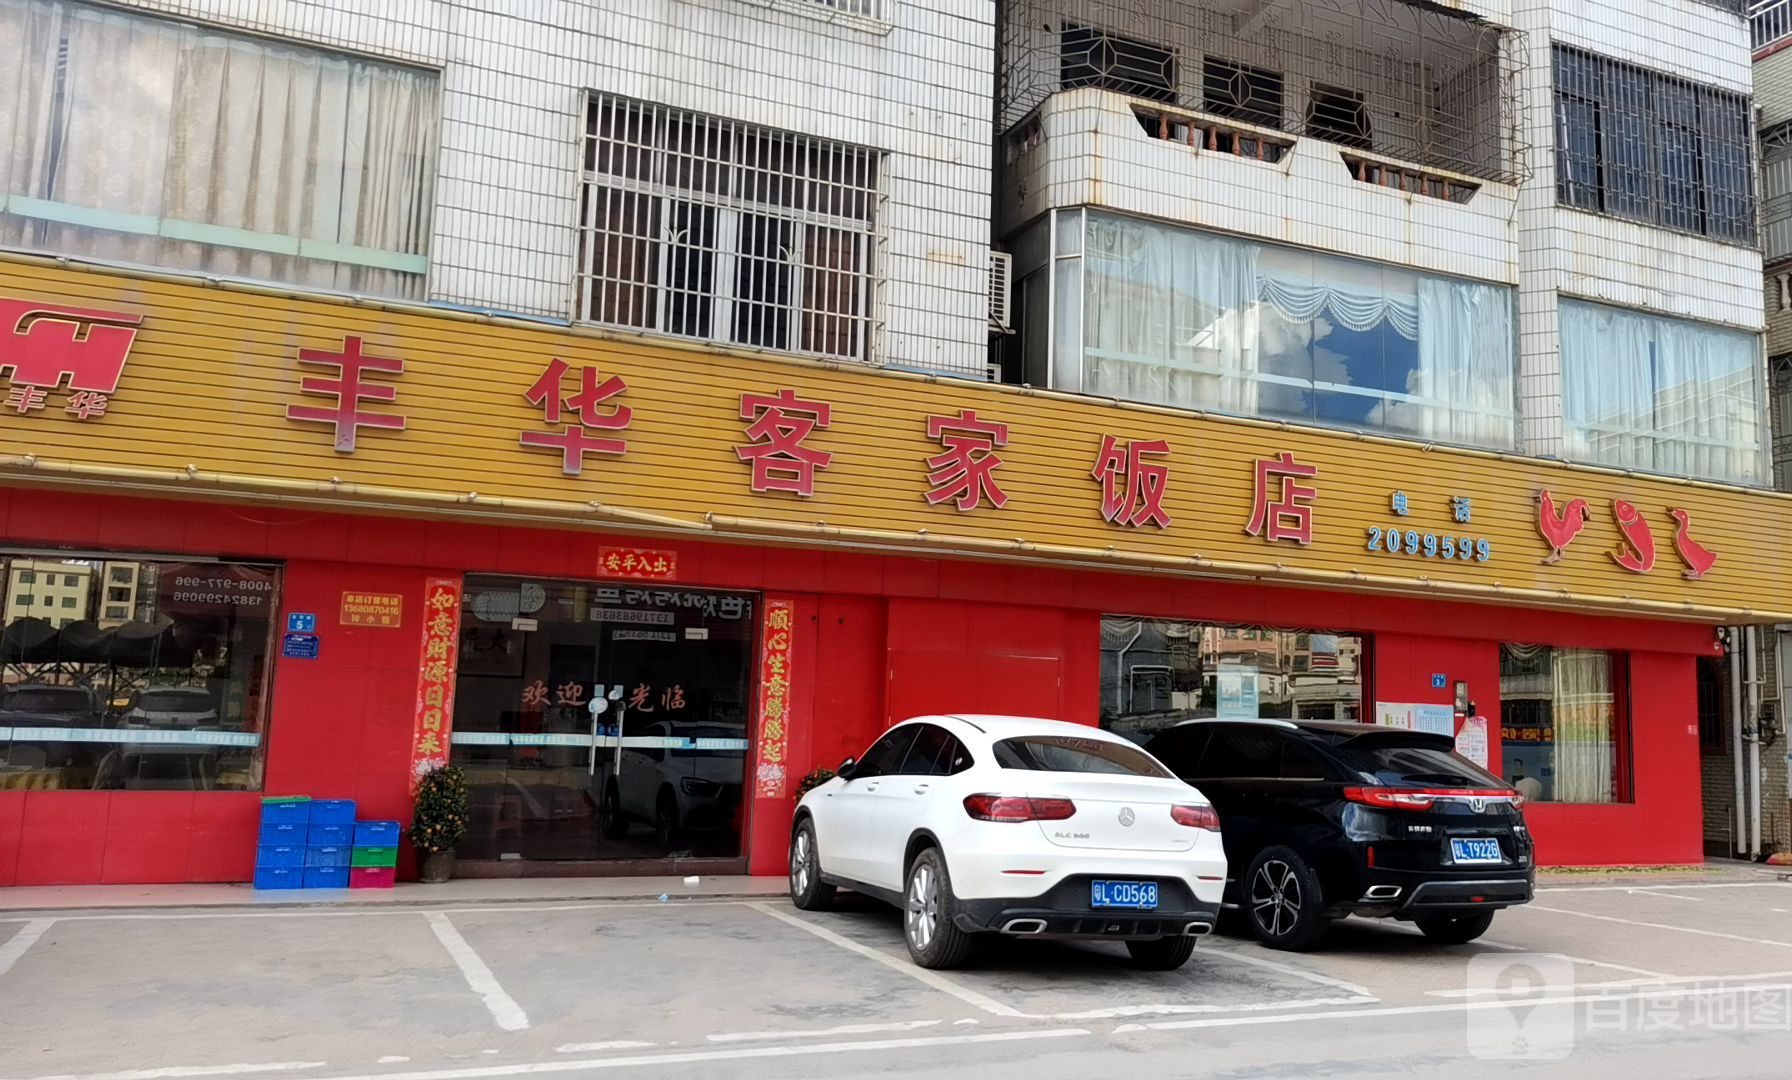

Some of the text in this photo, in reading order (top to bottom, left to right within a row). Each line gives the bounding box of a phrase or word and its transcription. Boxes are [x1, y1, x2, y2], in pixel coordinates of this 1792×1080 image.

[3, 385, 108, 419] 丰华
[285, 335, 1318, 545] 丰华客家饭店
[1391, 489, 1472, 522] 电话
[1368, 525, 1490, 562] 2099599
